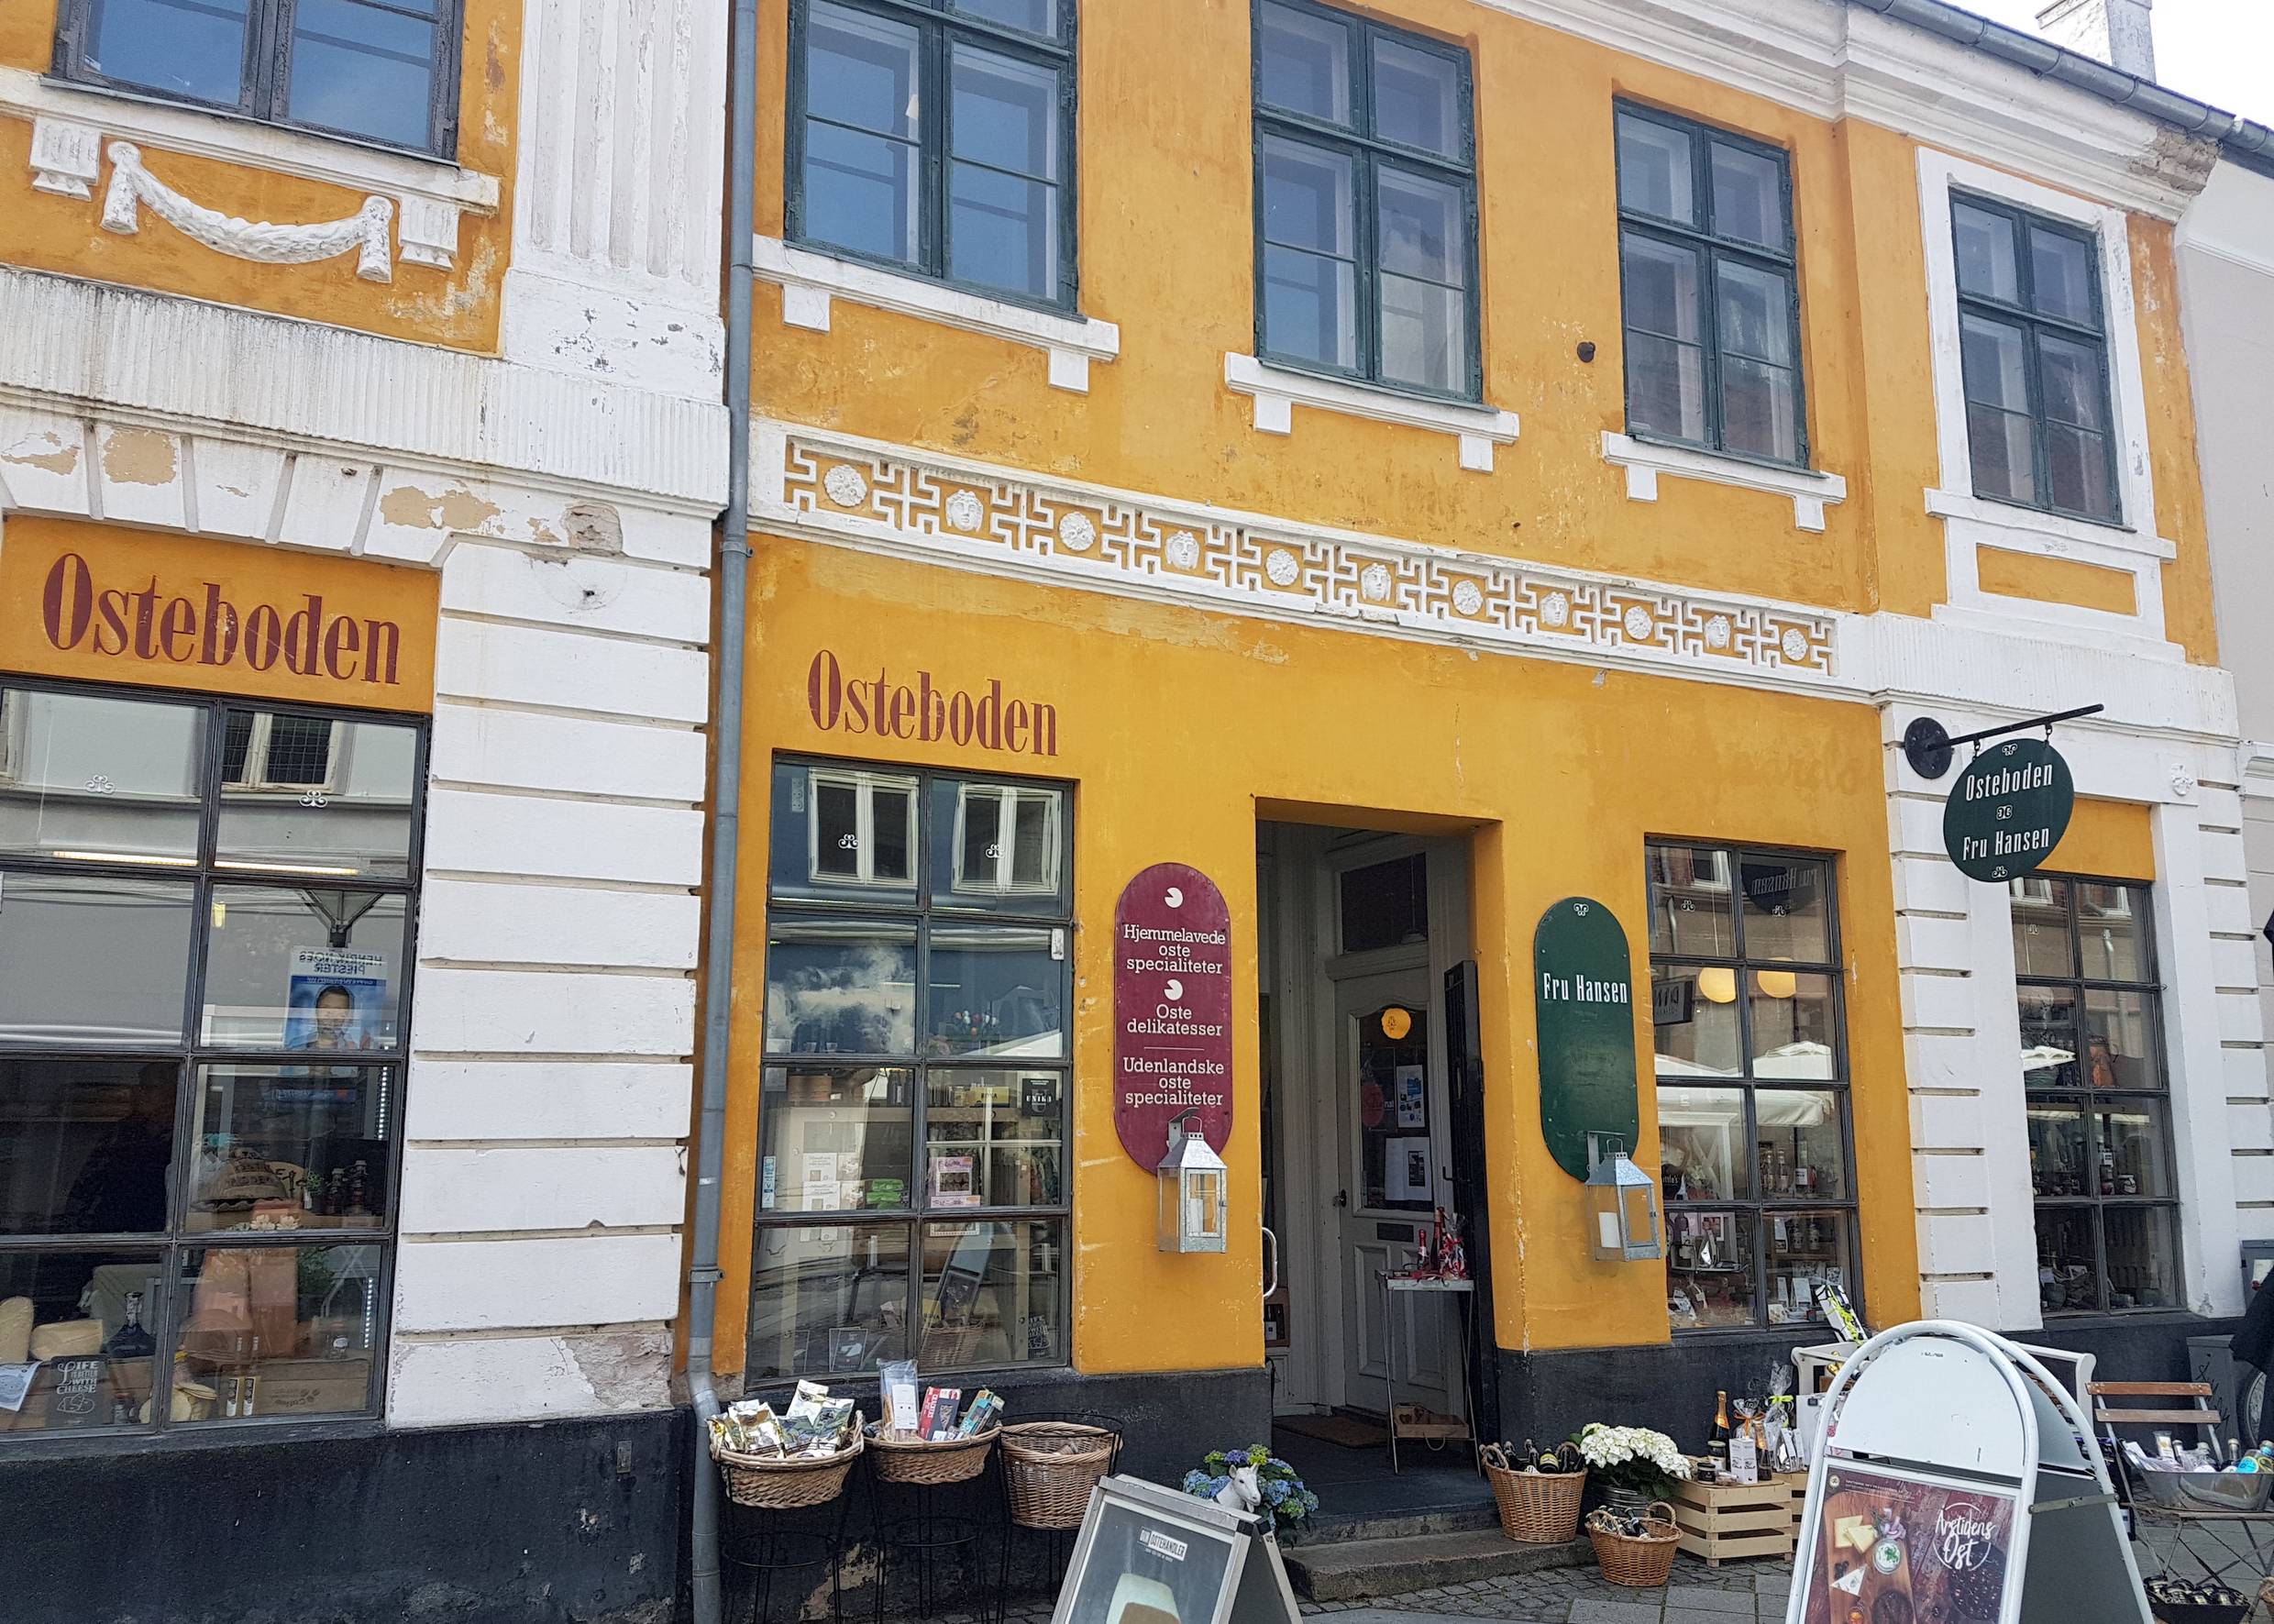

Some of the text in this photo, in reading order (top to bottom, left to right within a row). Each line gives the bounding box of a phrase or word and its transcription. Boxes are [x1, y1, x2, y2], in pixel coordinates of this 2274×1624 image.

[43, 553, 400, 685] Osteboden
[807, 649, 1058, 757] Osteboden
[1965, 762, 2053, 801] Osteboden
[1962, 827, 2049, 861] Fru Hansen
[1123, 923, 1226, 945] Hjemmelavede
[1158, 944, 1191, 956] oste
[1126, 956, 1223, 974] specialiteter
[1543, 972, 1570, 1000] Fru
[1576, 974, 1628, 1003] Hansen
[1156, 1003, 1192, 1020] Oste
[1127, 1018, 1223, 1036] delikatesser
[1122, 1056, 1224, 1075] Udenlandske
[1158, 1075, 1191, 1089] oste
[1125, 1089, 1223, 1108] specialiteter
